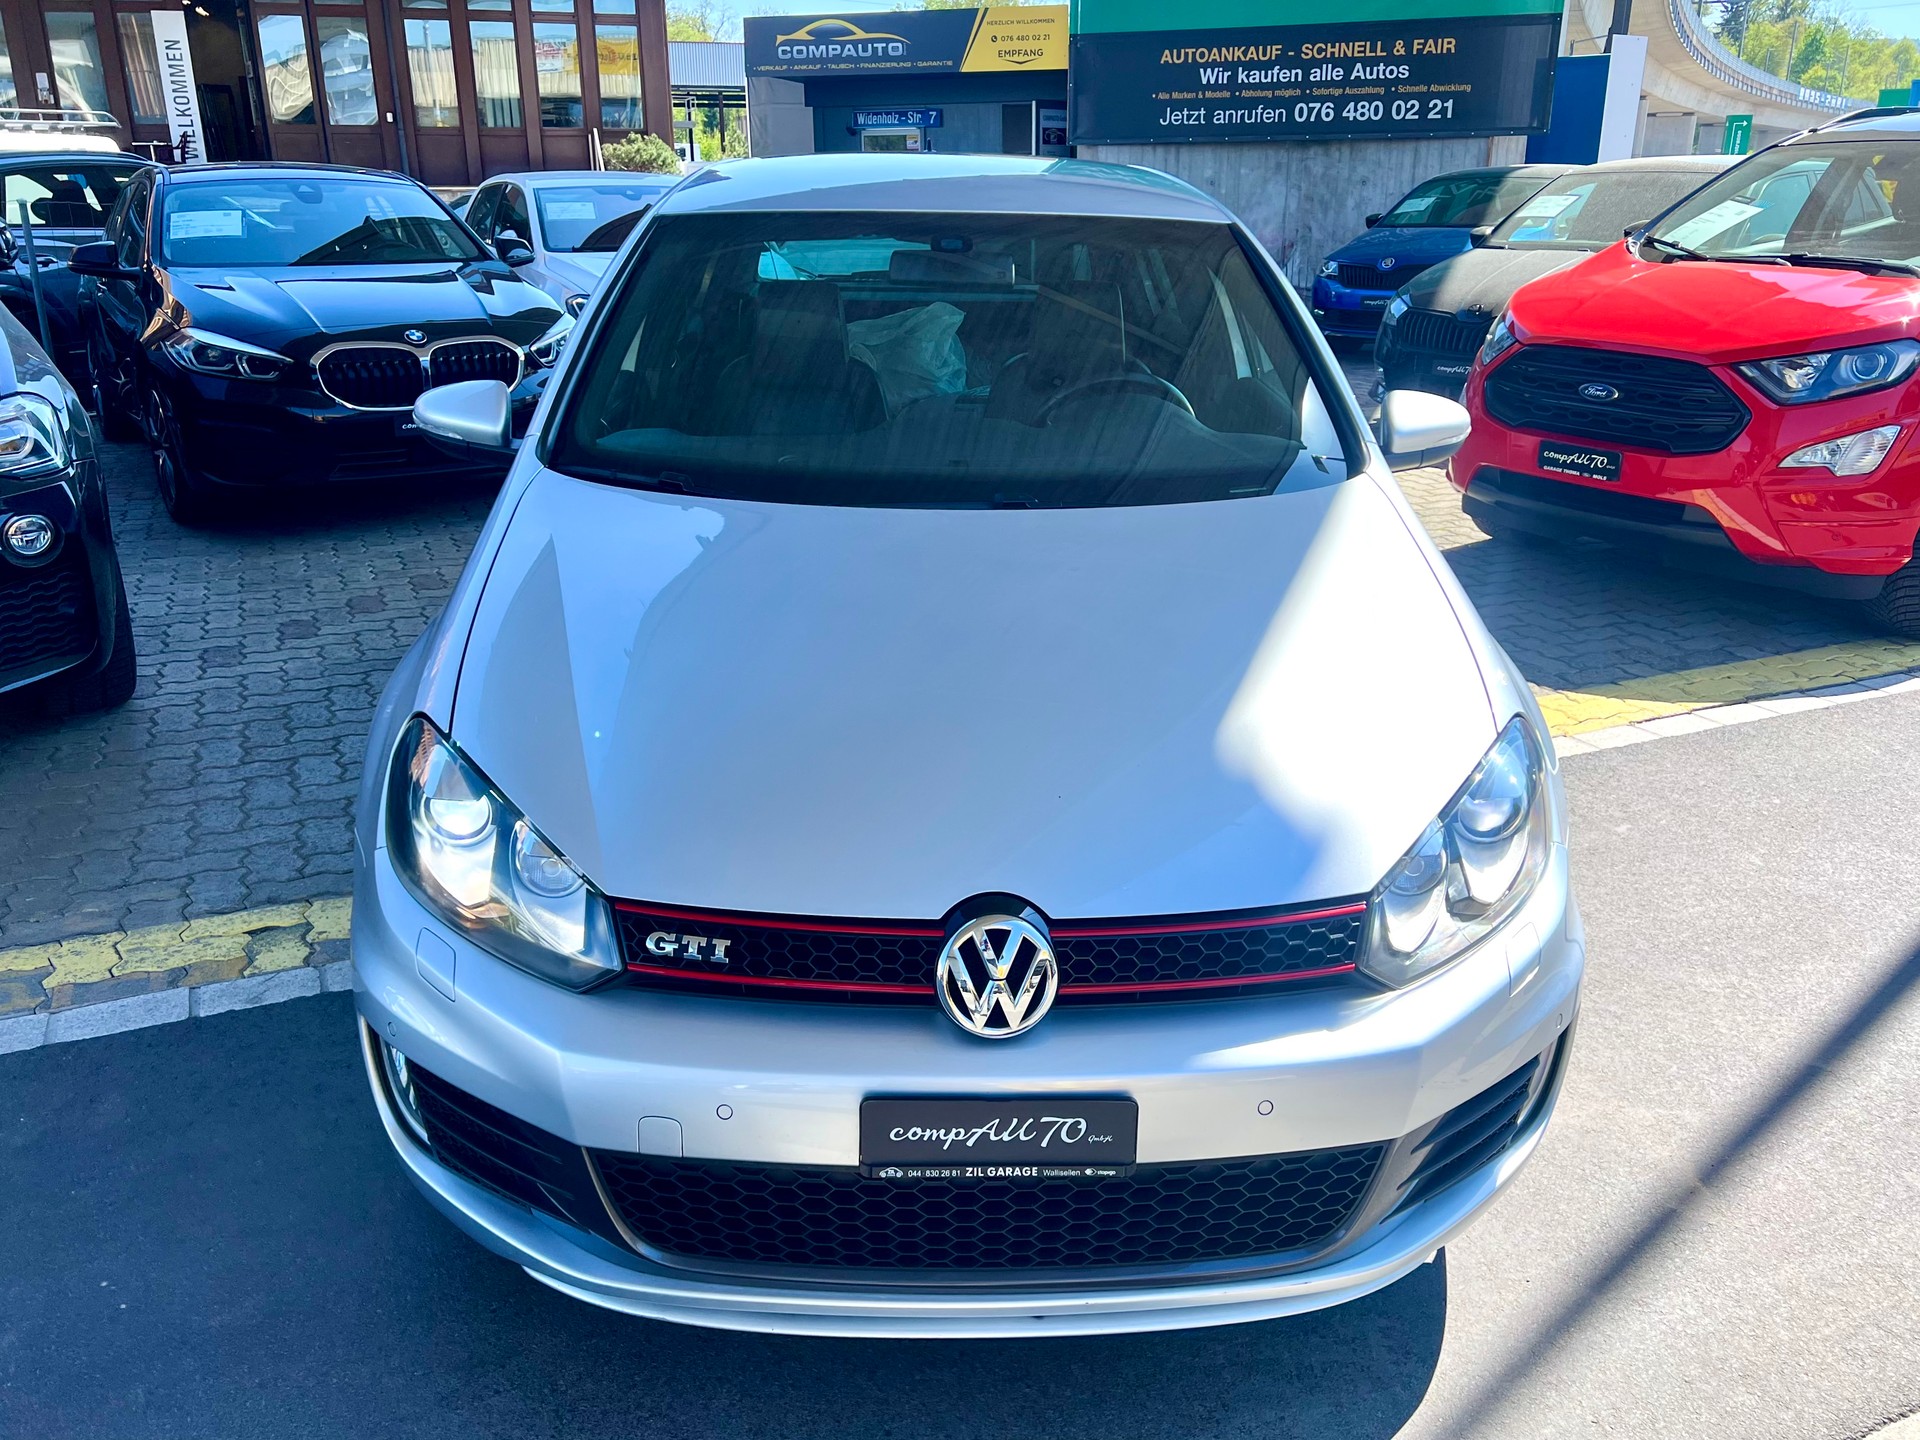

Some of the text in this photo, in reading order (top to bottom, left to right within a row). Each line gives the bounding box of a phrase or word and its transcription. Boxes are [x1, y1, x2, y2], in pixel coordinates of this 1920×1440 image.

[777, 42, 903, 60] COMPAUTO
[998, 48, 1044, 58] EMPFANG
[1160, 45, 1283, 64] AUTOANKAUF
[1301, 41, 1387, 60] SCHNELL
[1393, 39, 1406, 56] &
[1412, 37, 1456, 55] FAIR
[1200, 62, 1410, 85] Wir kaufen alle Autos
[164, 39, 199, 160] WILLKOMMEN
[1172, 91, 1196, 99] Marken
[1205, 90, 1231, 98] Modelle
[1241, 89, 1273, 98] Abholung
[1274, 88, 1301, 97] möglich
[1312, 87, 1343, 96] Sofortige
[1344, 86, 1385, 95] Auszahlung
[1398, 84, 1428, 93] Schnelle
[1430, 83, 1472, 92] Abwicklung
[929, 111, 937, 124] 7
[1159, 98, 1454, 125] Jetzt anrufen 076 480 02 21
[1584, 385, 1608, 398] Ford
[645, 931, 731, 963] GTI
[943, 920, 1055, 1034] VW
[908, 1169, 921, 1177] 044
[925, 1169, 939, 1177] 830
[951, 1169, 961, 1177] 81
[965, 1167, 984, 1177] ZIL
[987, 1167, 1038, 1177] GARAGE
